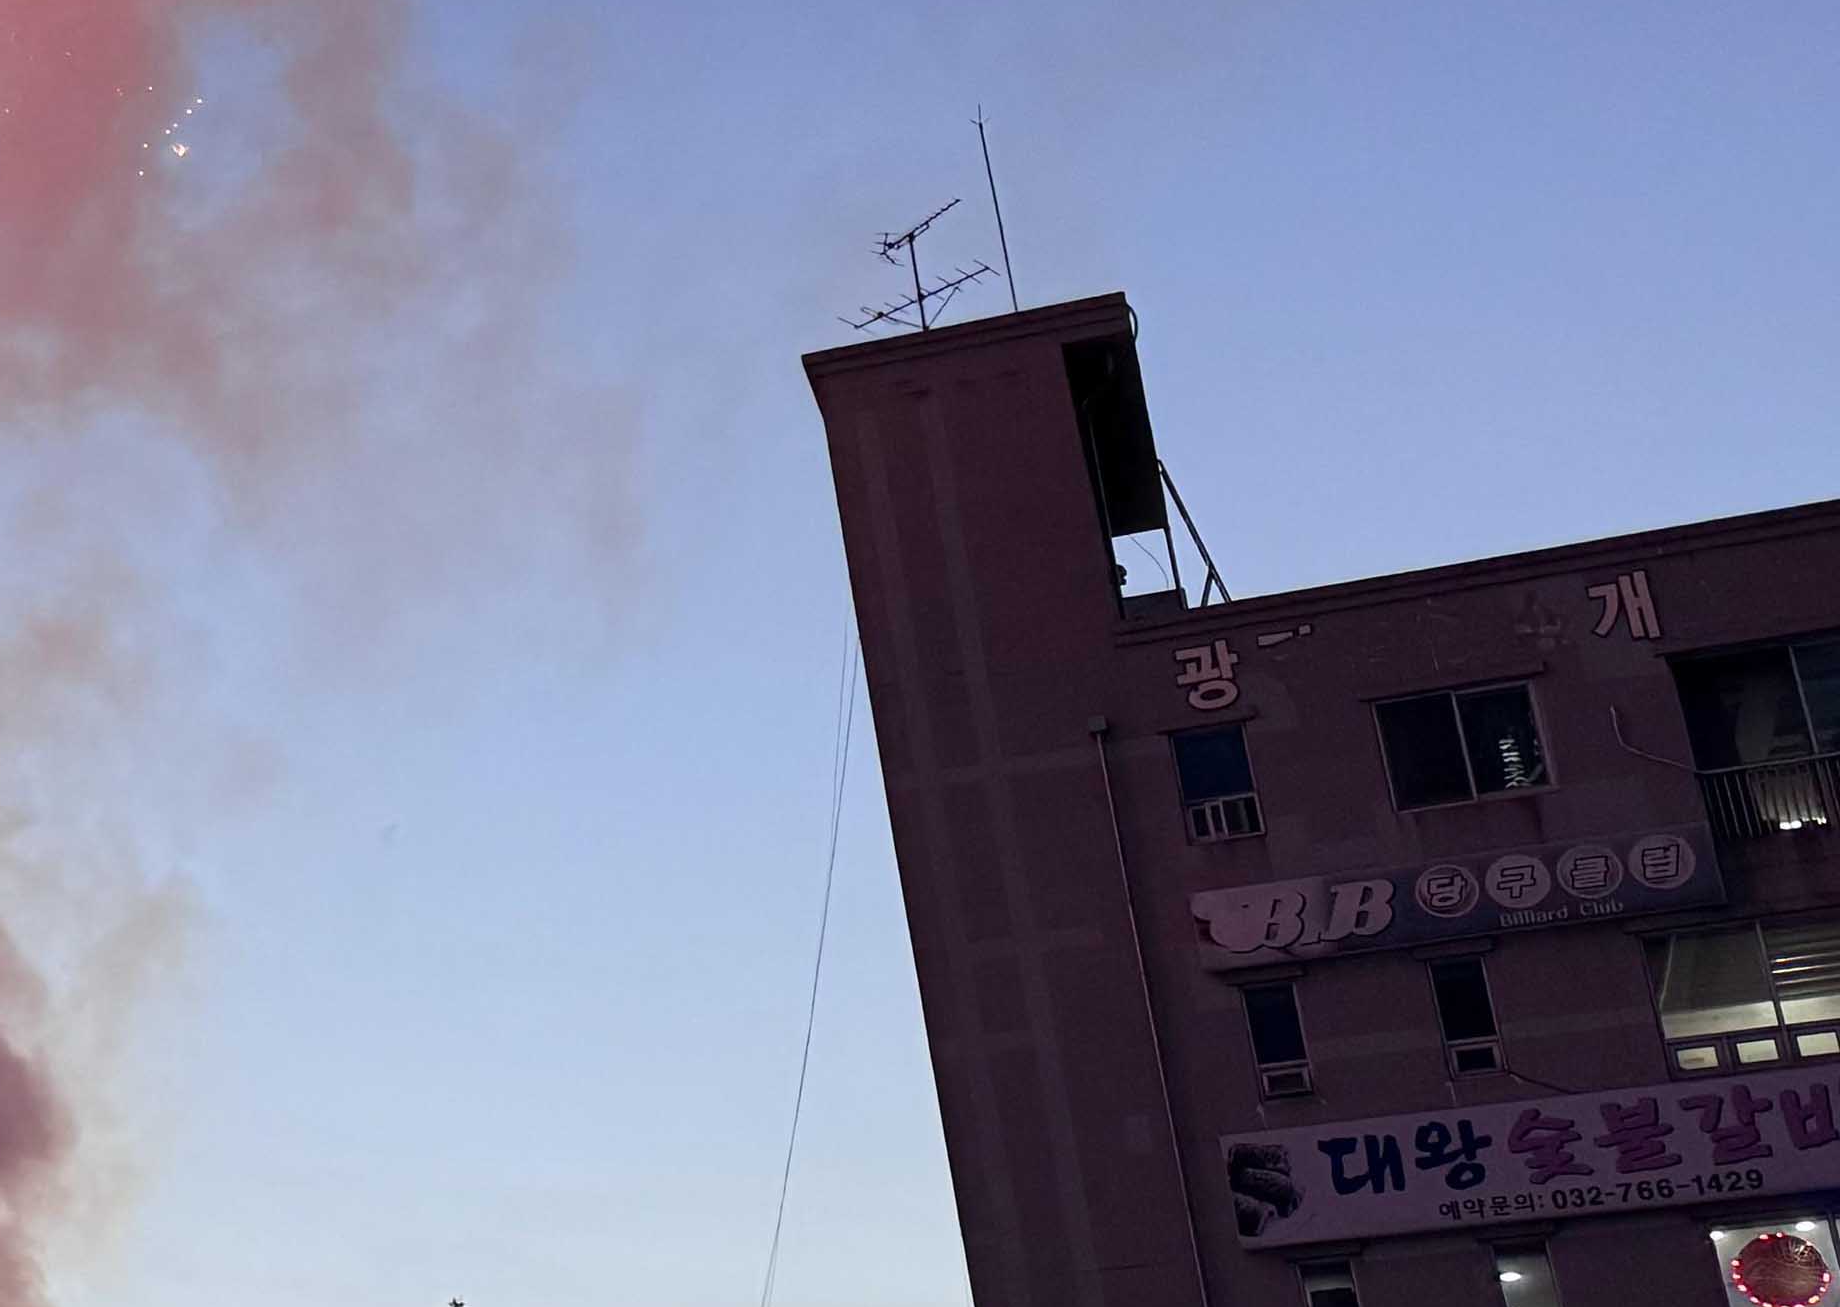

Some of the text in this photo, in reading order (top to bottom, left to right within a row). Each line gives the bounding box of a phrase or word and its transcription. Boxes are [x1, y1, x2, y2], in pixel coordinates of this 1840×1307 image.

[1424, 840, 1685, 913] 당구클럽
[1498, 901, 1625, 929] Billiard Club
[1552, 1168, 1765, 1211] 032-766-1429
